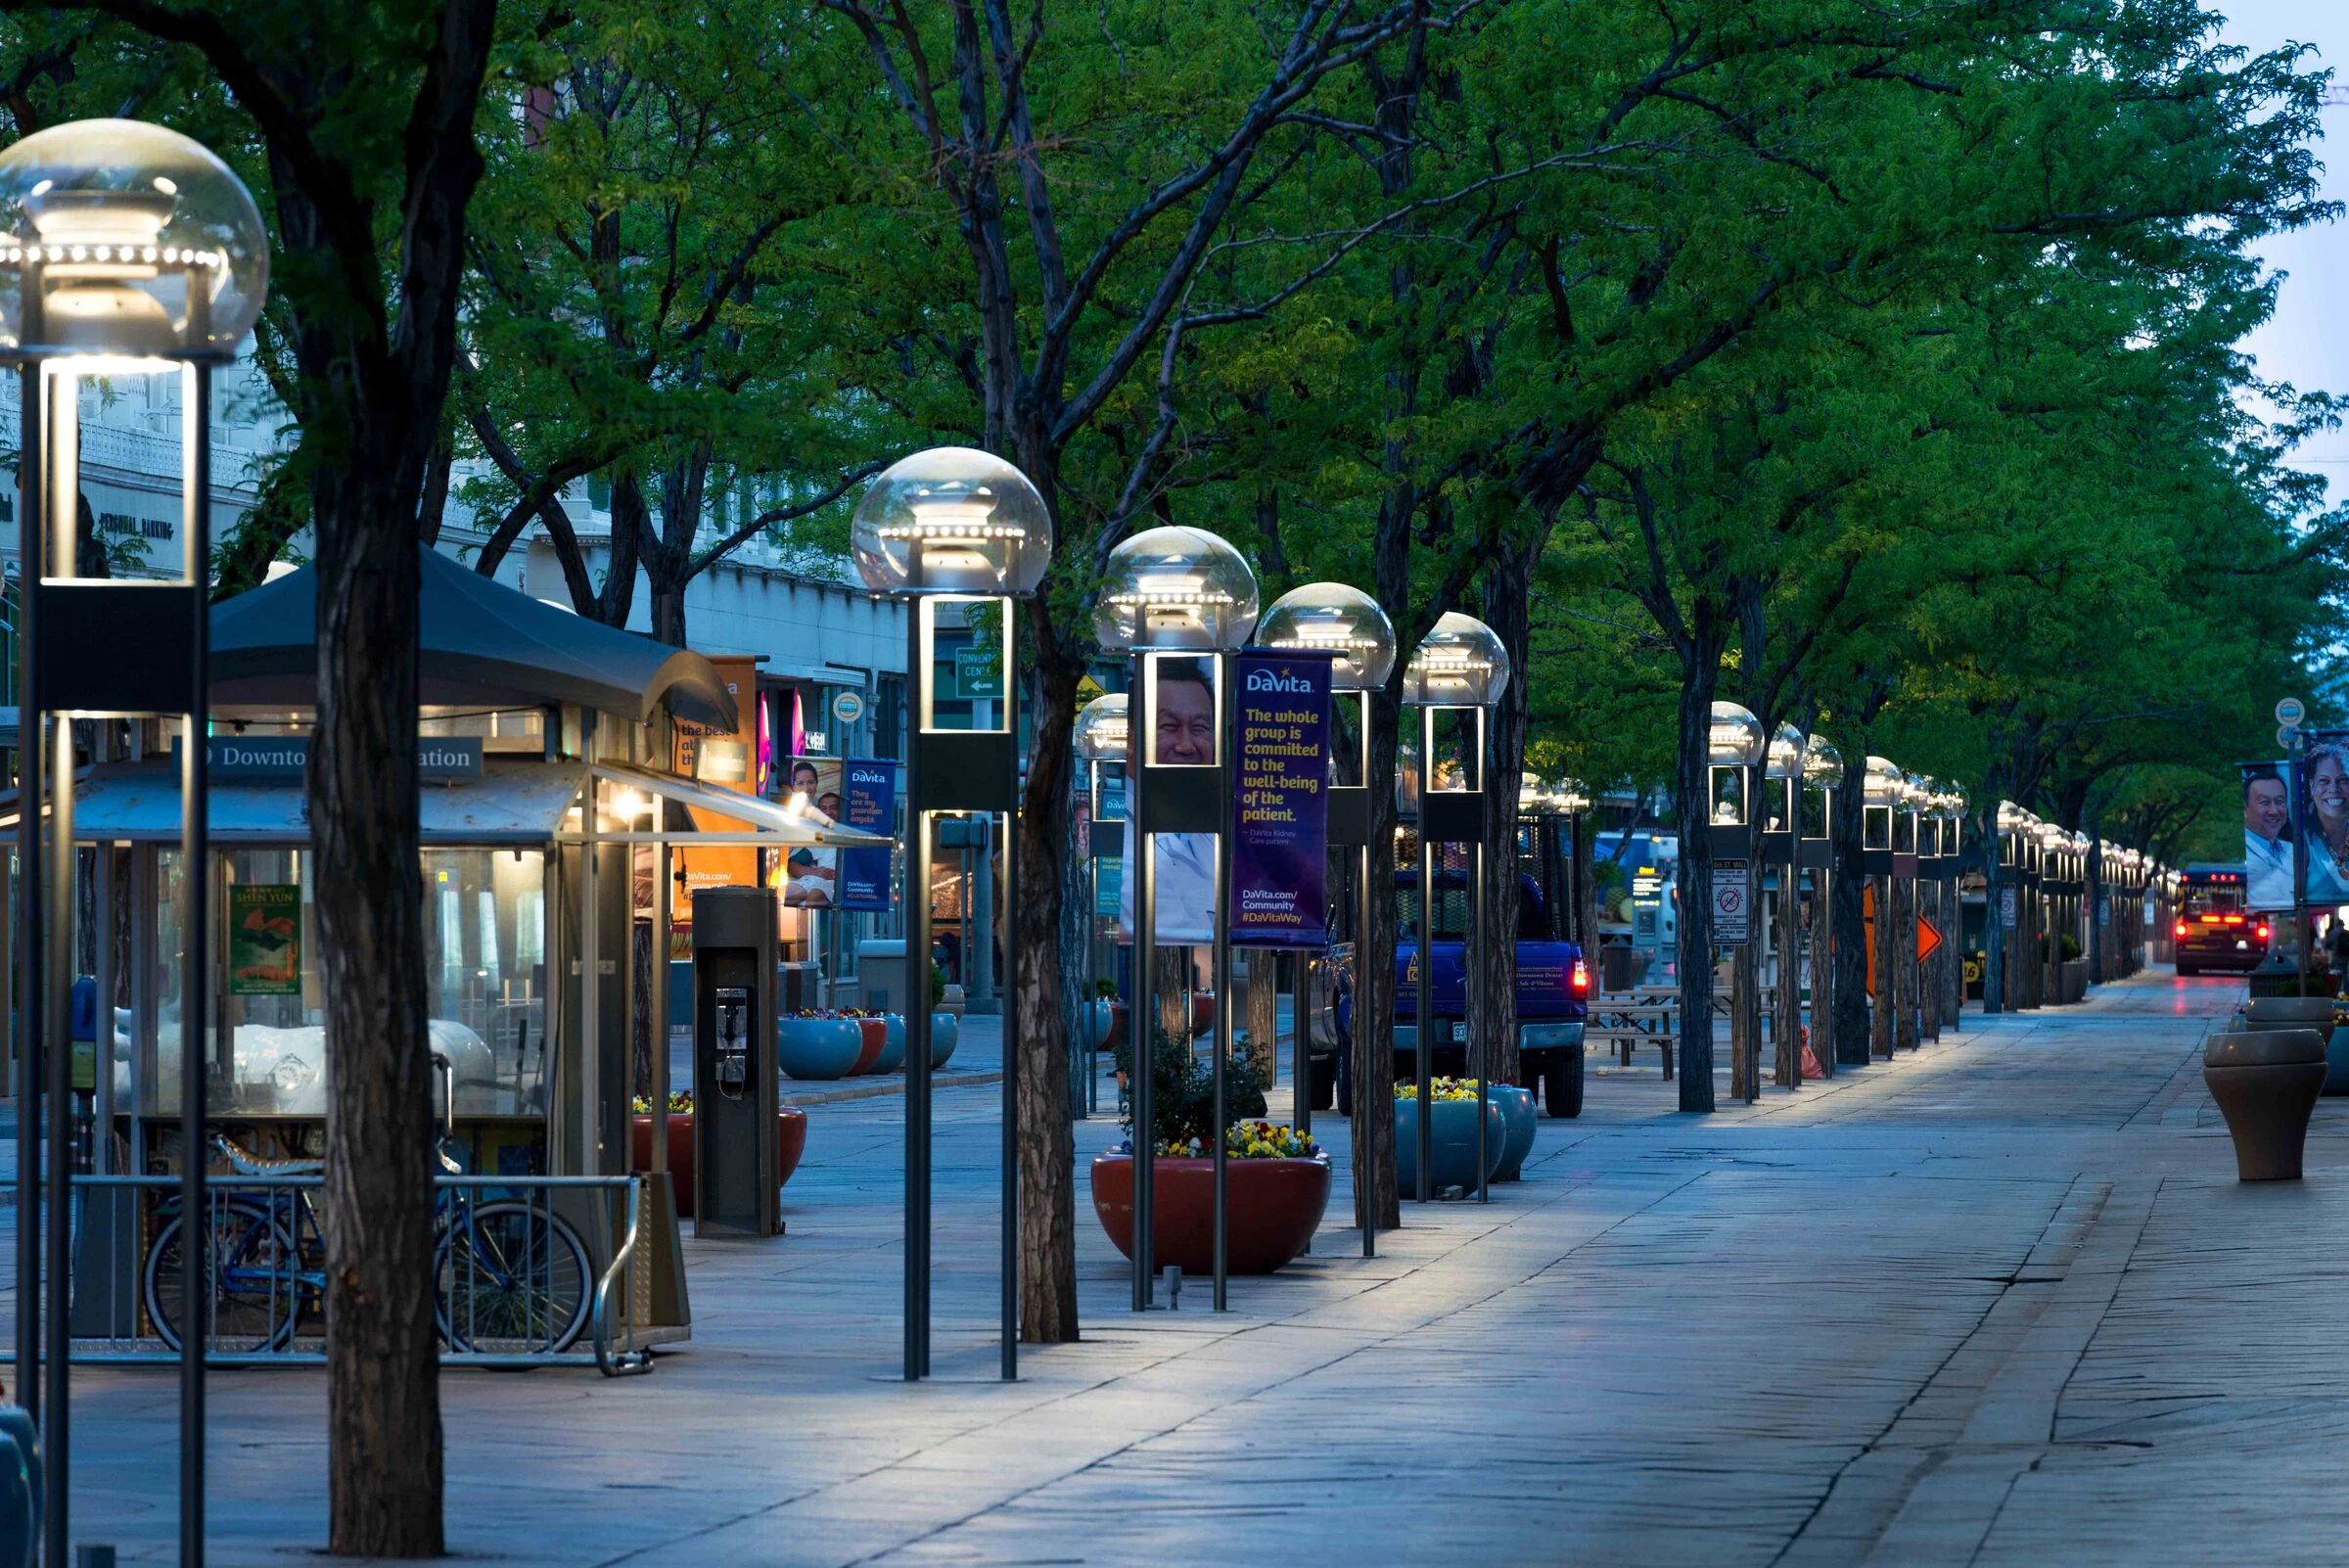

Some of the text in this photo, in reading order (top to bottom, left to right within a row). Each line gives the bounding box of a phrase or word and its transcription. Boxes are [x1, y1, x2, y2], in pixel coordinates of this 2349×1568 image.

[958, 653, 996, 664] CONVENT
[1247, 669, 1313, 693] DaVita
[1246, 709, 1319, 723] The whole
[681, 724, 702, 736] the
[1245, 725, 1302, 742] group is
[1244, 742, 1318, 757] committed
[222, 747, 470, 767] Downto ation
[1244, 758, 1284, 771] to the
[852, 770, 885, 783] DaVita
[1243, 775, 1318, 794] well-being
[852, 790, 869, 800] They
[1243, 791, 1284, 807] of the
[864, 799, 876, 807] my
[851, 807, 883, 815] guardian
[1243, 807, 1297, 823] patient.
[237, 893, 294, 902] SHEN YUN
[1243, 890, 1298, 900] DaVita.com/
[1242, 900, 1294, 911] Community
[1242, 912, 1302, 924] #DaVitaWay
[1454, 1028, 1465, 1037] 93
